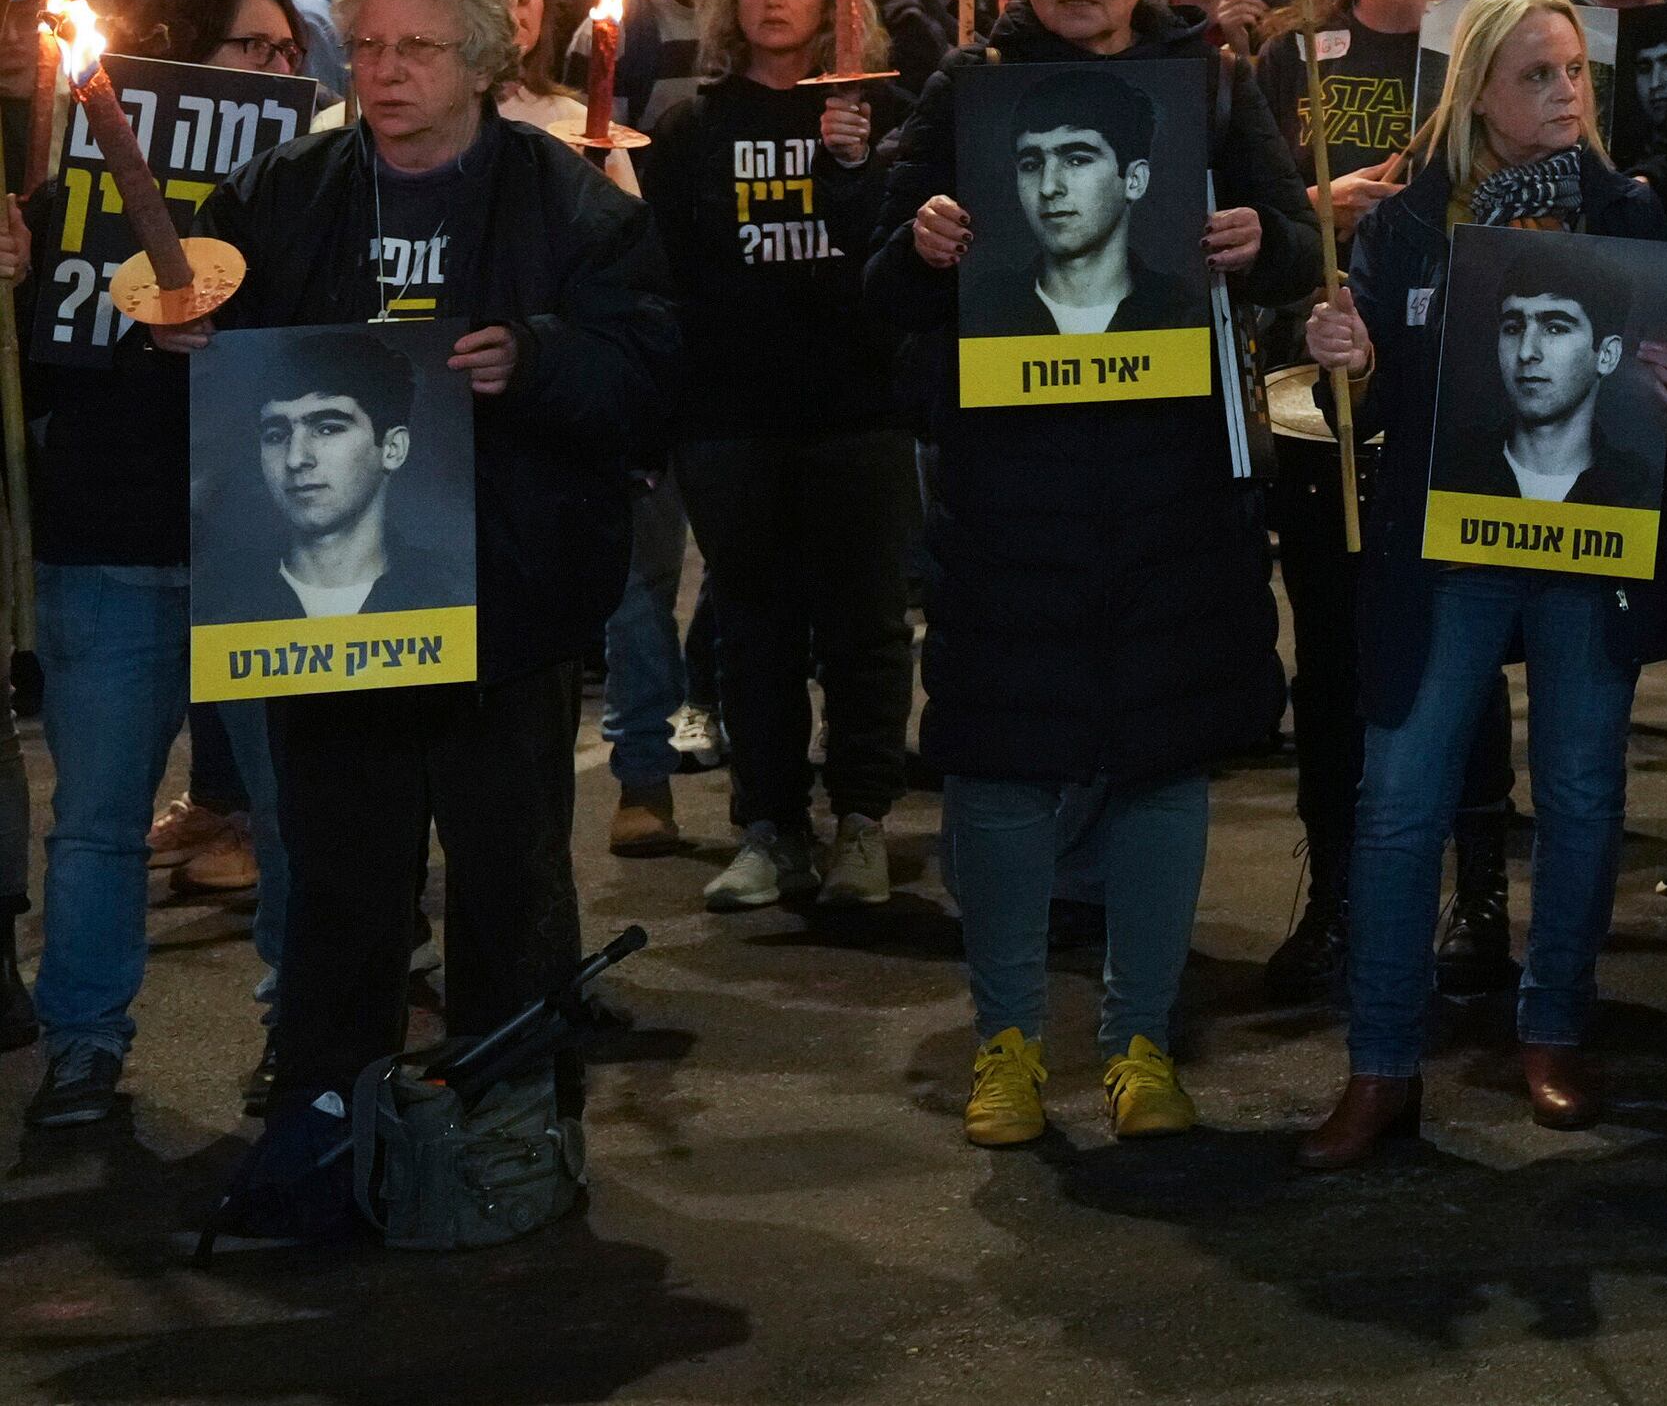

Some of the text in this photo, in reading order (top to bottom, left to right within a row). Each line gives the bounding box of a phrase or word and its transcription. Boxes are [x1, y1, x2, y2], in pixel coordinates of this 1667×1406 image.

[1297, 75, 1408, 114] STA
[170, 96, 298, 174] למה
[734, 140, 776, 179] הם
[735, 178, 814, 223] דיין
[738, 219, 846, 265] עזה?
[1022, 355, 1151, 393] יאיר הורן
[1460, 517, 1624, 560] מתן אנגרסט
[228, 634, 443, 680] איציק אלגרט
